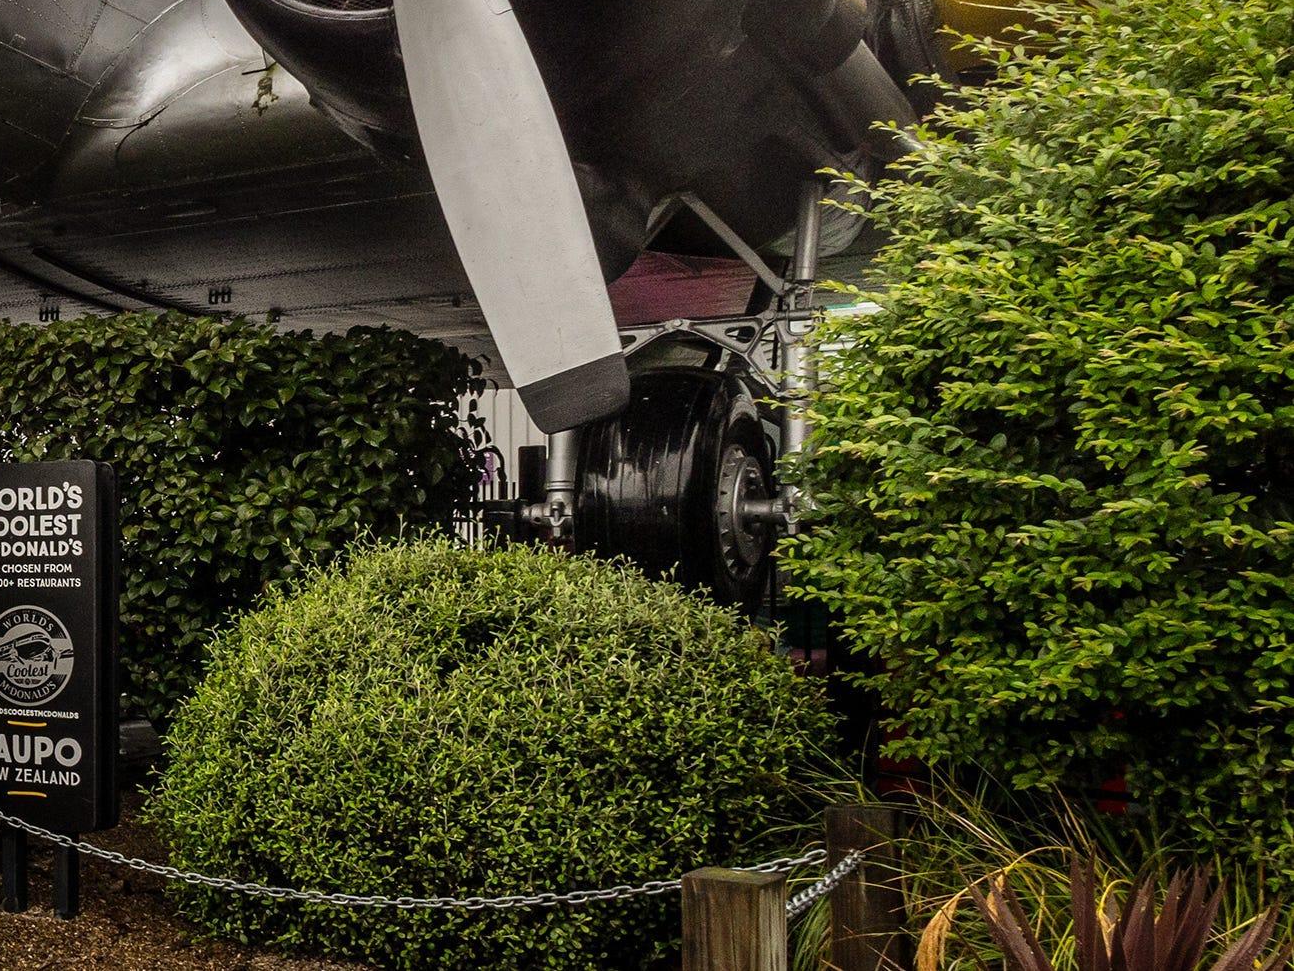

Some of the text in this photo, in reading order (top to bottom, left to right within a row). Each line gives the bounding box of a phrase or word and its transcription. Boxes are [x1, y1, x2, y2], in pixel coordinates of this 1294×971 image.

[1, 563, 41, 574] CHOSEN
[43, 563, 72, 573] FROM
[17, 578, 82, 588] RESTAURANTS
[6, 664, 49, 679] Coolest
[14, 767, 81, 787] ZEALAND
